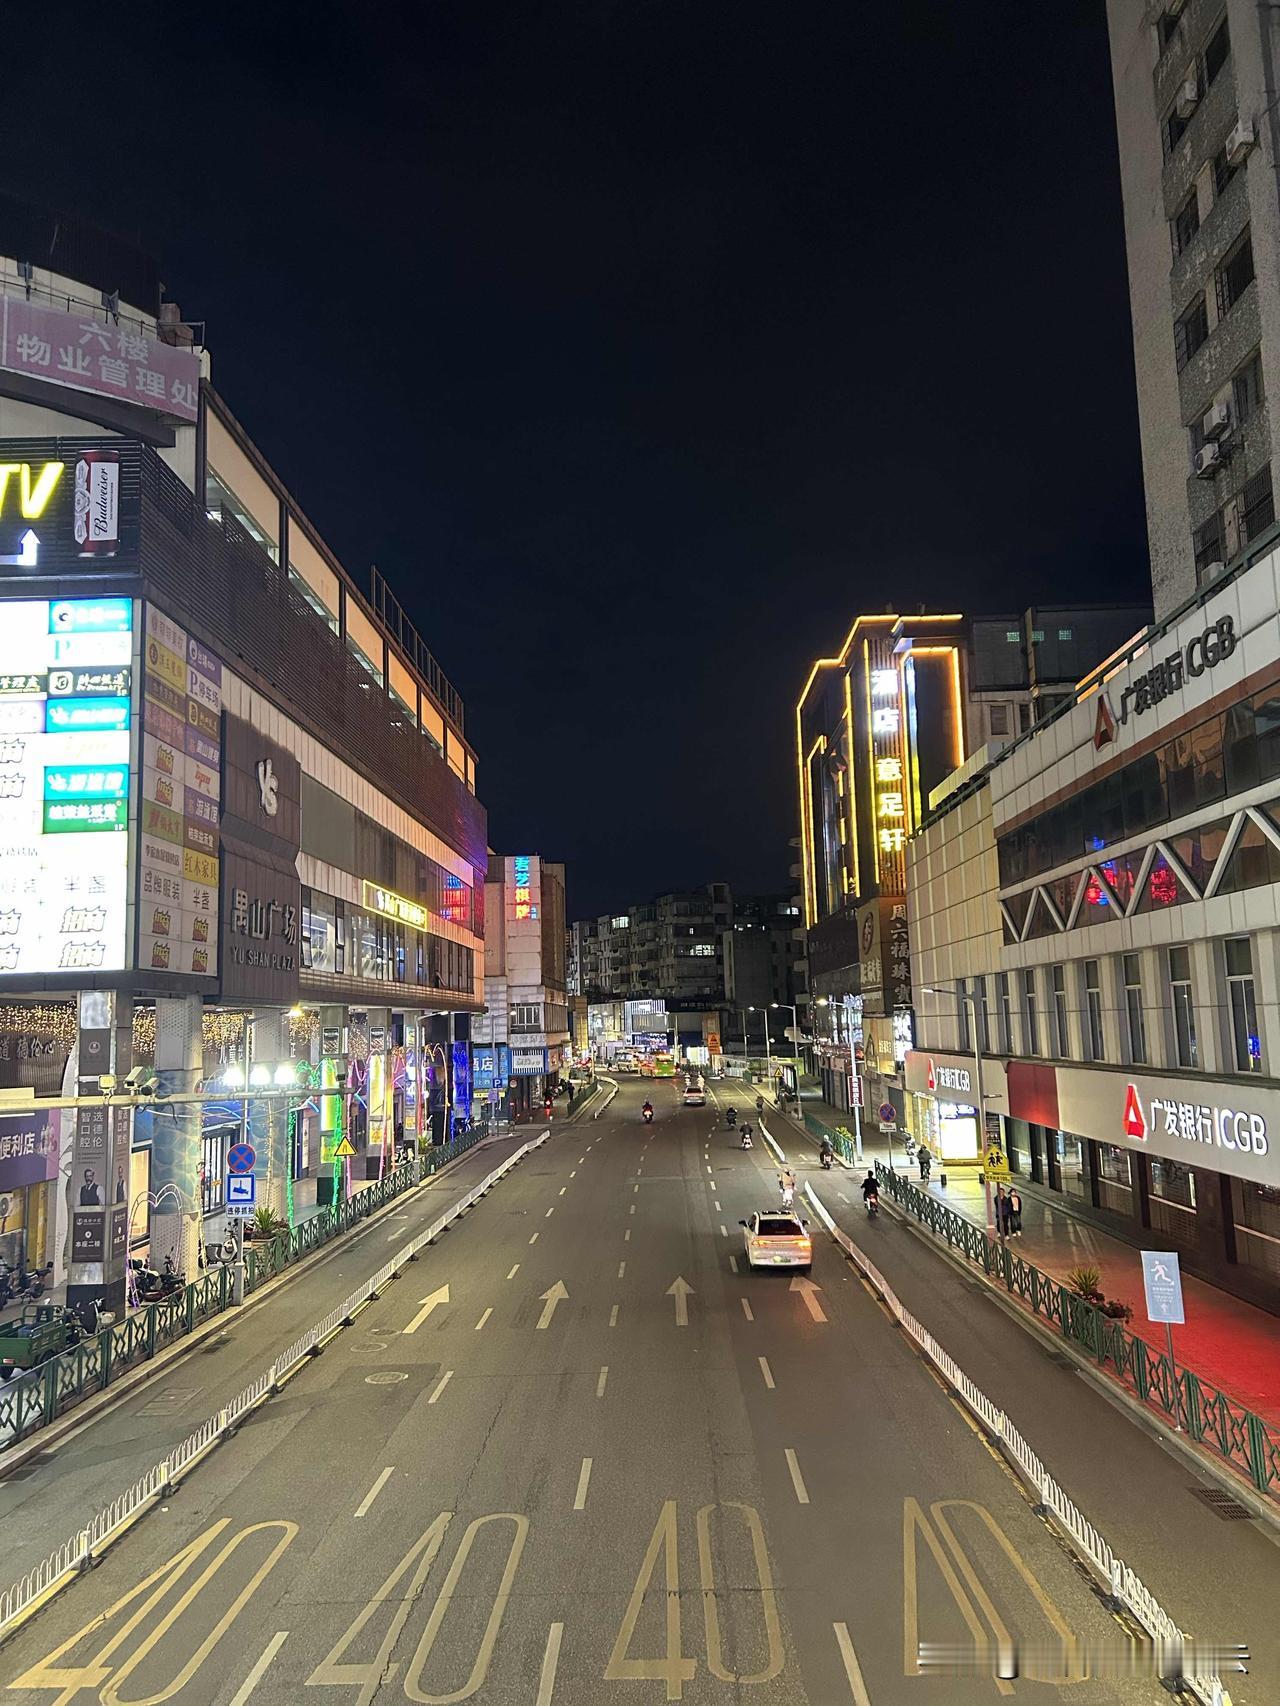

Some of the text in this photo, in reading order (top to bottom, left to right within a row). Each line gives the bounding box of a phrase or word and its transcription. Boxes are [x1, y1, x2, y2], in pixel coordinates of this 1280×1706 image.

[16, 332, 198, 412] 物业管理处
[79, 320, 149, 364] 六楼
[94, 467, 109, 536] Budweiser
[1186, 615, 1236, 677] CGB
[144, 870, 180, 901] 品牌服装
[232, 888, 297, 945] 禺山广场
[233, 946, 296, 971] YU SHAN PLAZA
[0, 1132, 35, 1160] 便利店
[1150, 1098, 1268, 1156] 广发银行 CGB
[4, 1517, 299, 1706] 40
[304, 1510, 530, 1706] 40
[603, 1500, 785, 1699] 40
